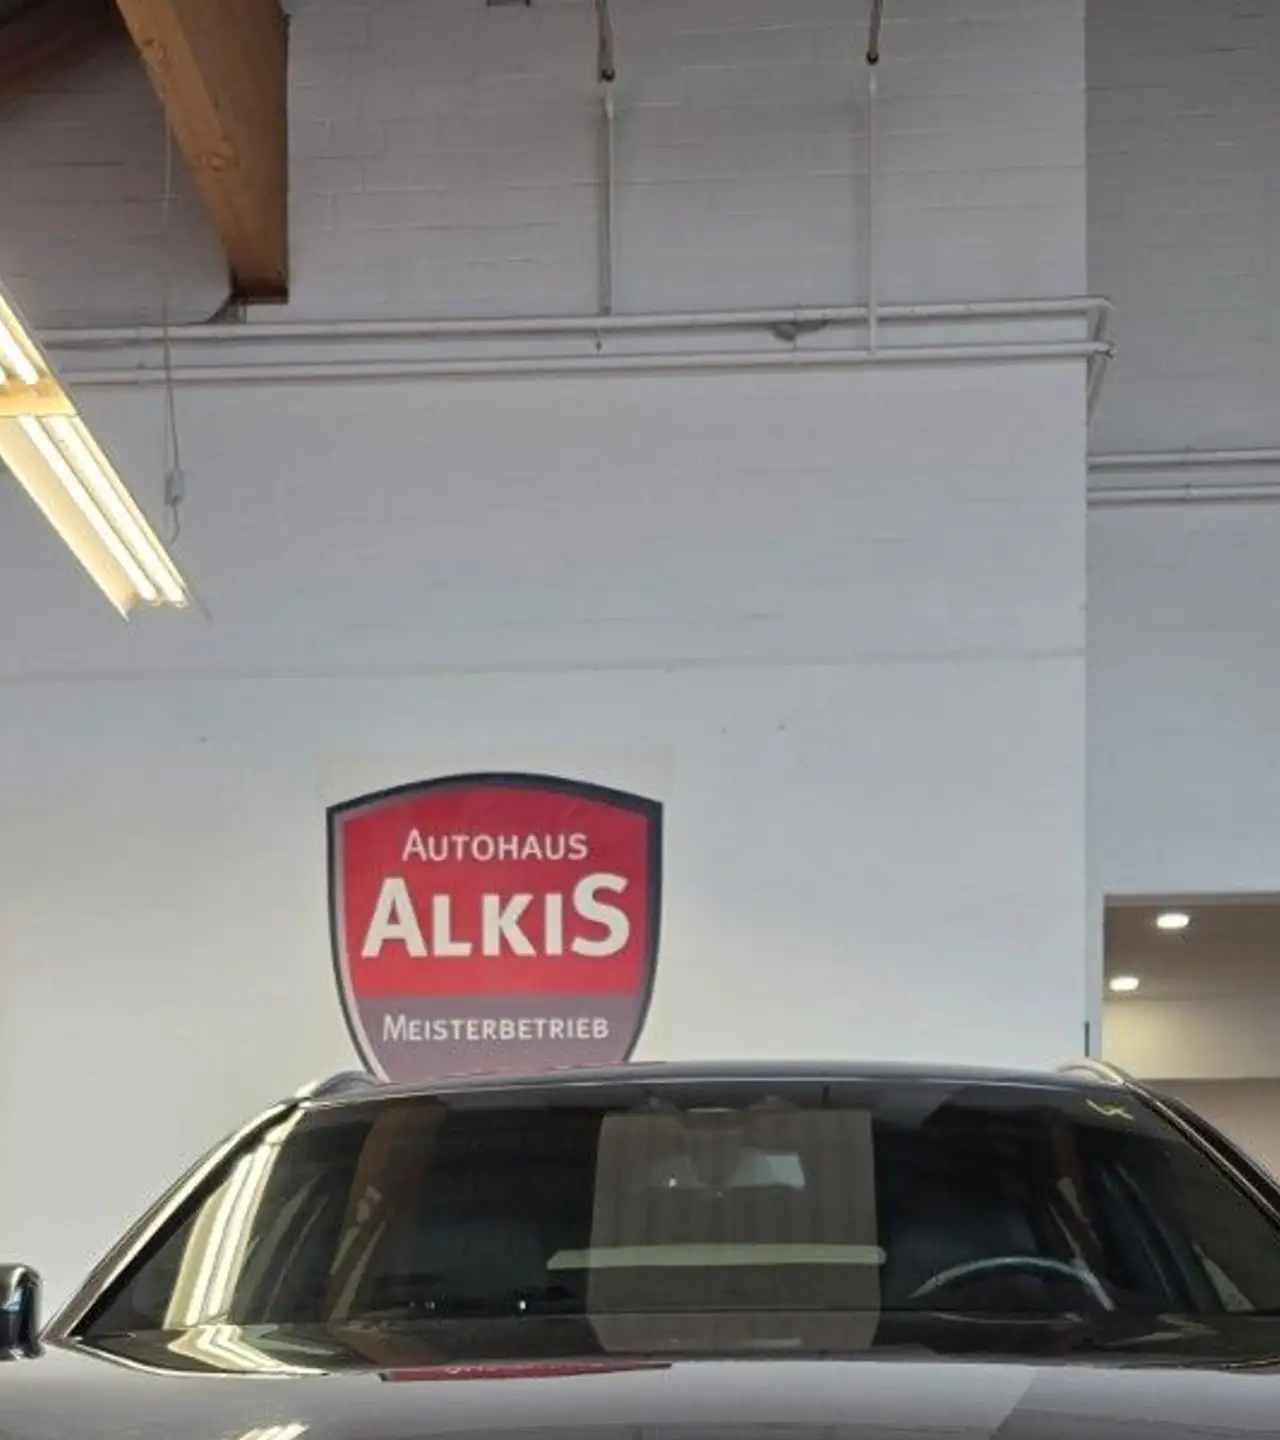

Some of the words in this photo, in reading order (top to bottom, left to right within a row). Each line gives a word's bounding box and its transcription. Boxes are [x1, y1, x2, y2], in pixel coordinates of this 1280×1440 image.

[402, 827, 589, 862] AUTOHAUS
[361, 872, 631, 959] ALKIS
[382, 1014, 610, 1042] MEISTERBETRIEB
